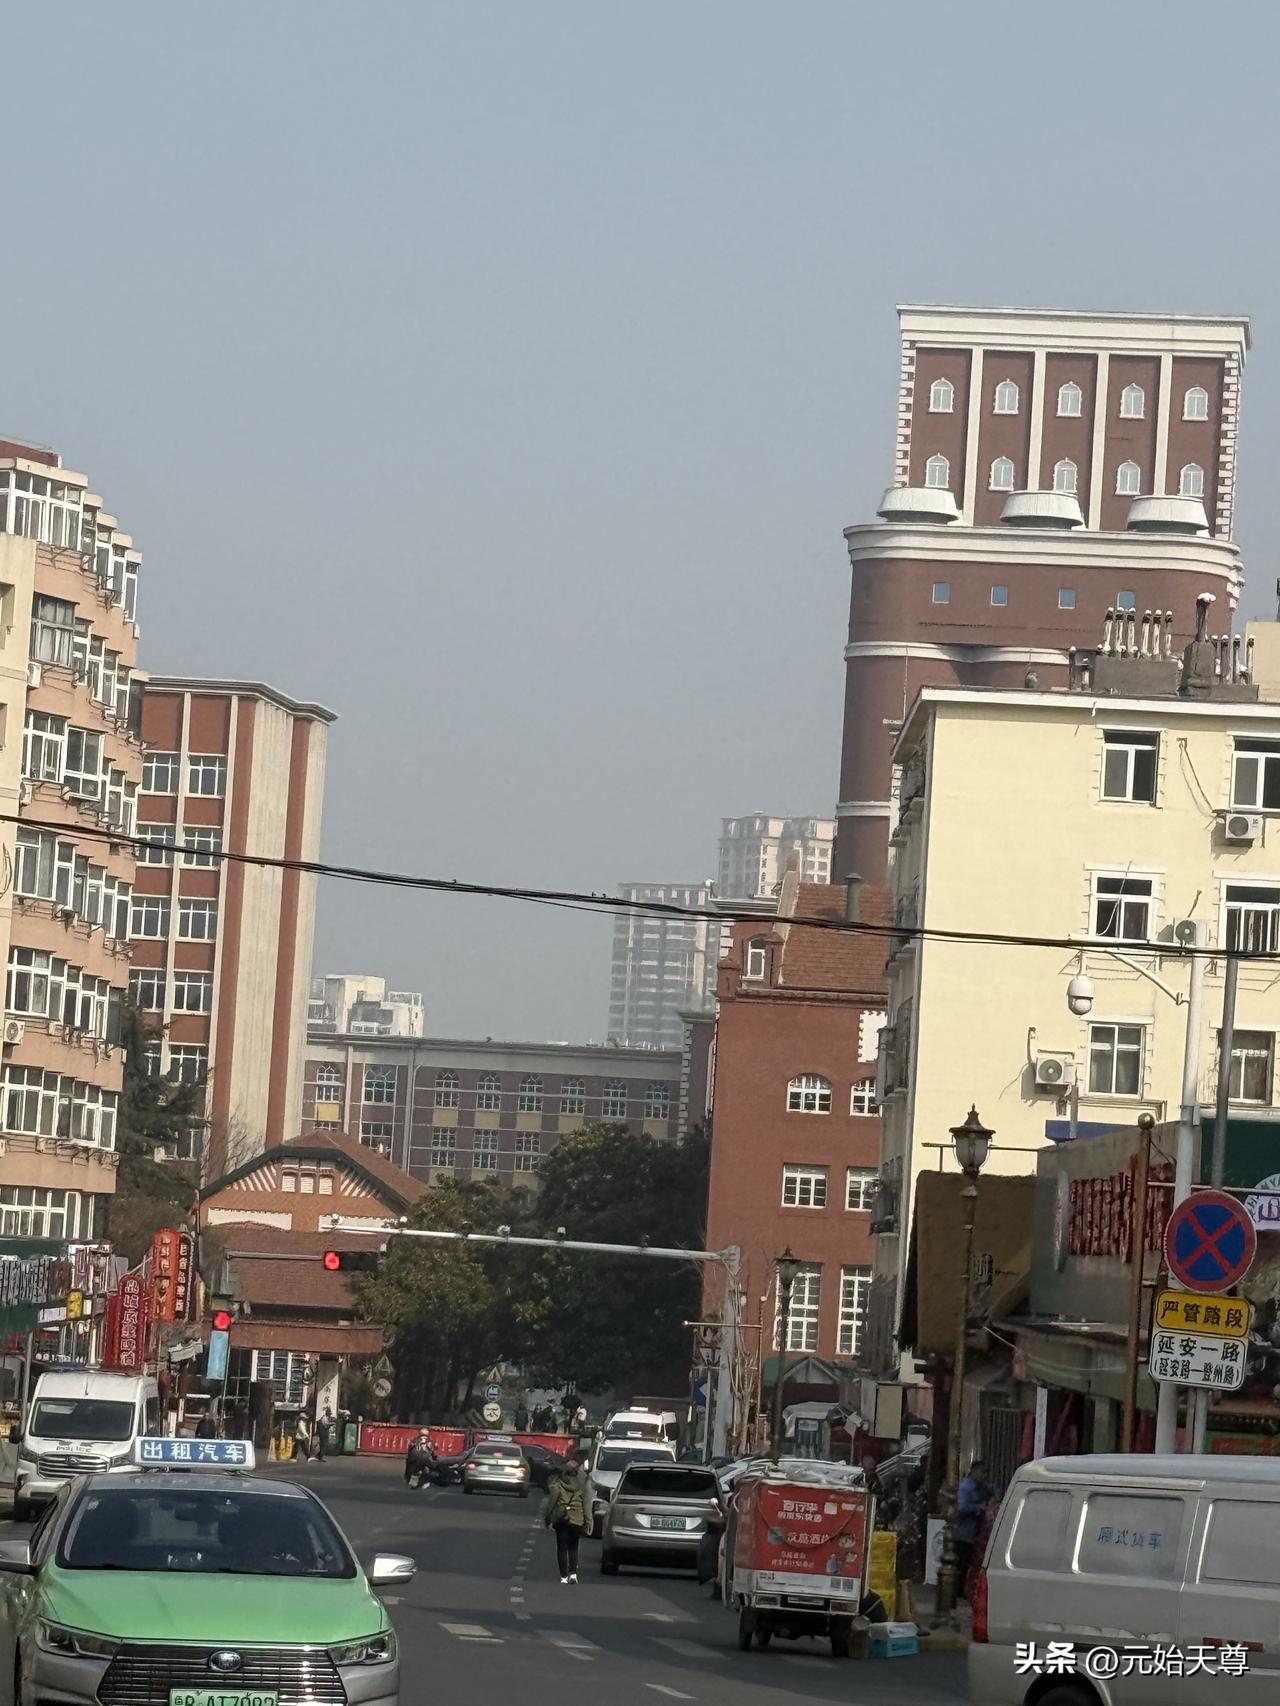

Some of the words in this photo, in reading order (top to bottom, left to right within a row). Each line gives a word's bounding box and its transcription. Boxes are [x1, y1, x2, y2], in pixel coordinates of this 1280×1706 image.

[1160, 1300, 1243, 1329] 严管路段
[1157, 1335, 1240, 1363] 延安一路
[143, 1441, 244, 1463] 出租汽车
[1097, 1526, 1163, 1550] 厢式货车
